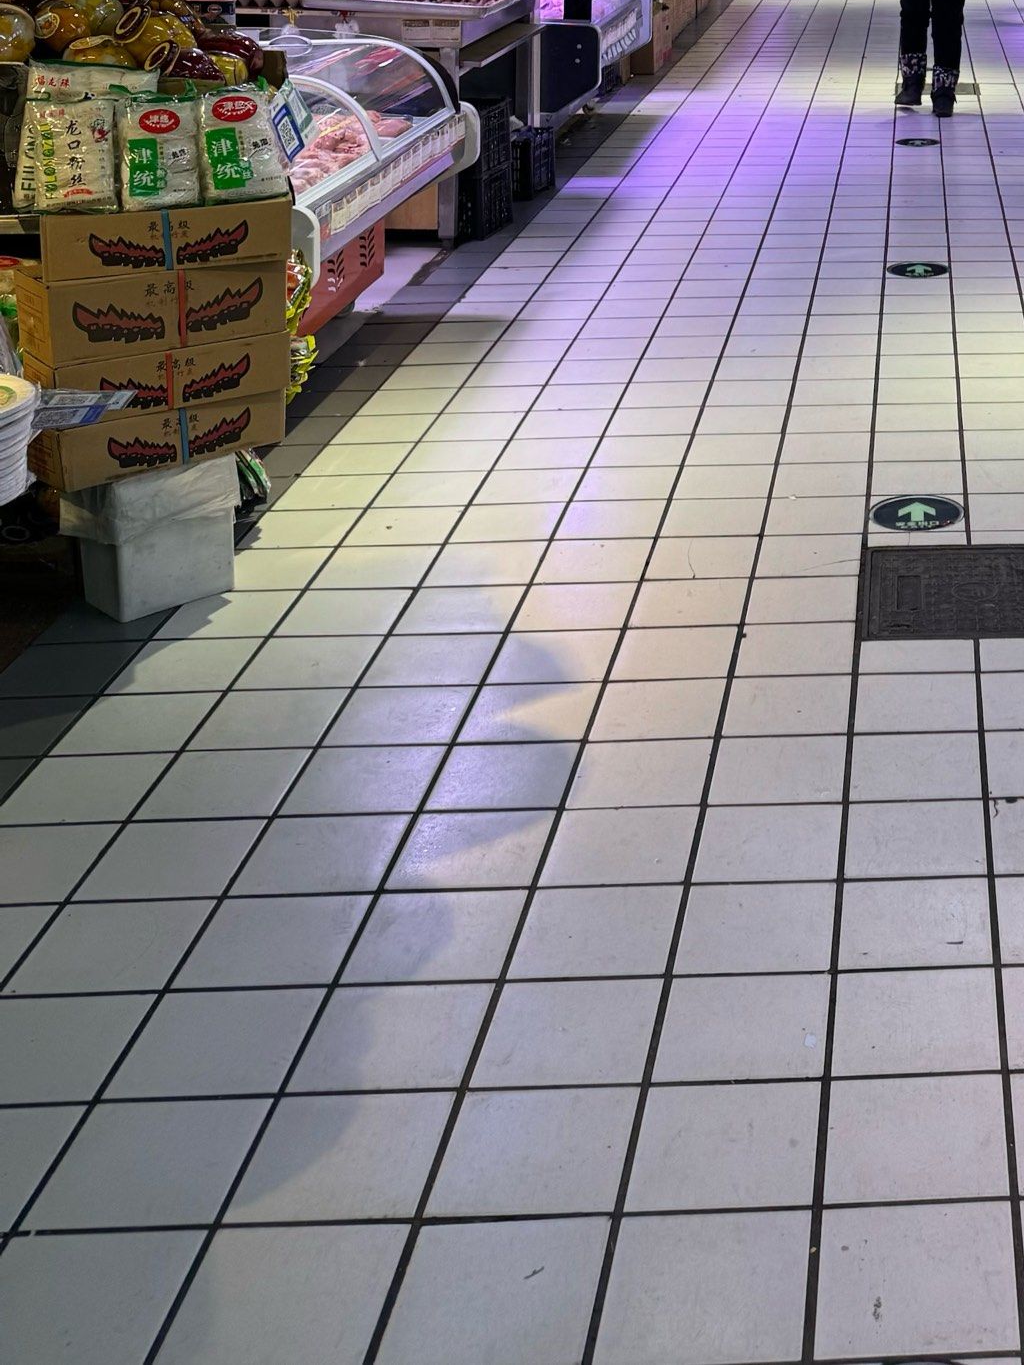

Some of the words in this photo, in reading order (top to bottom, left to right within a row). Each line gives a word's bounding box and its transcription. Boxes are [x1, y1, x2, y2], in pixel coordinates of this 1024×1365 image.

[65, 120, 87, 188] 龙口粉丝
[133, 147, 154, 187] 津统
[211, 138, 242, 180] 津统
[148, 220, 190, 232] 最级
